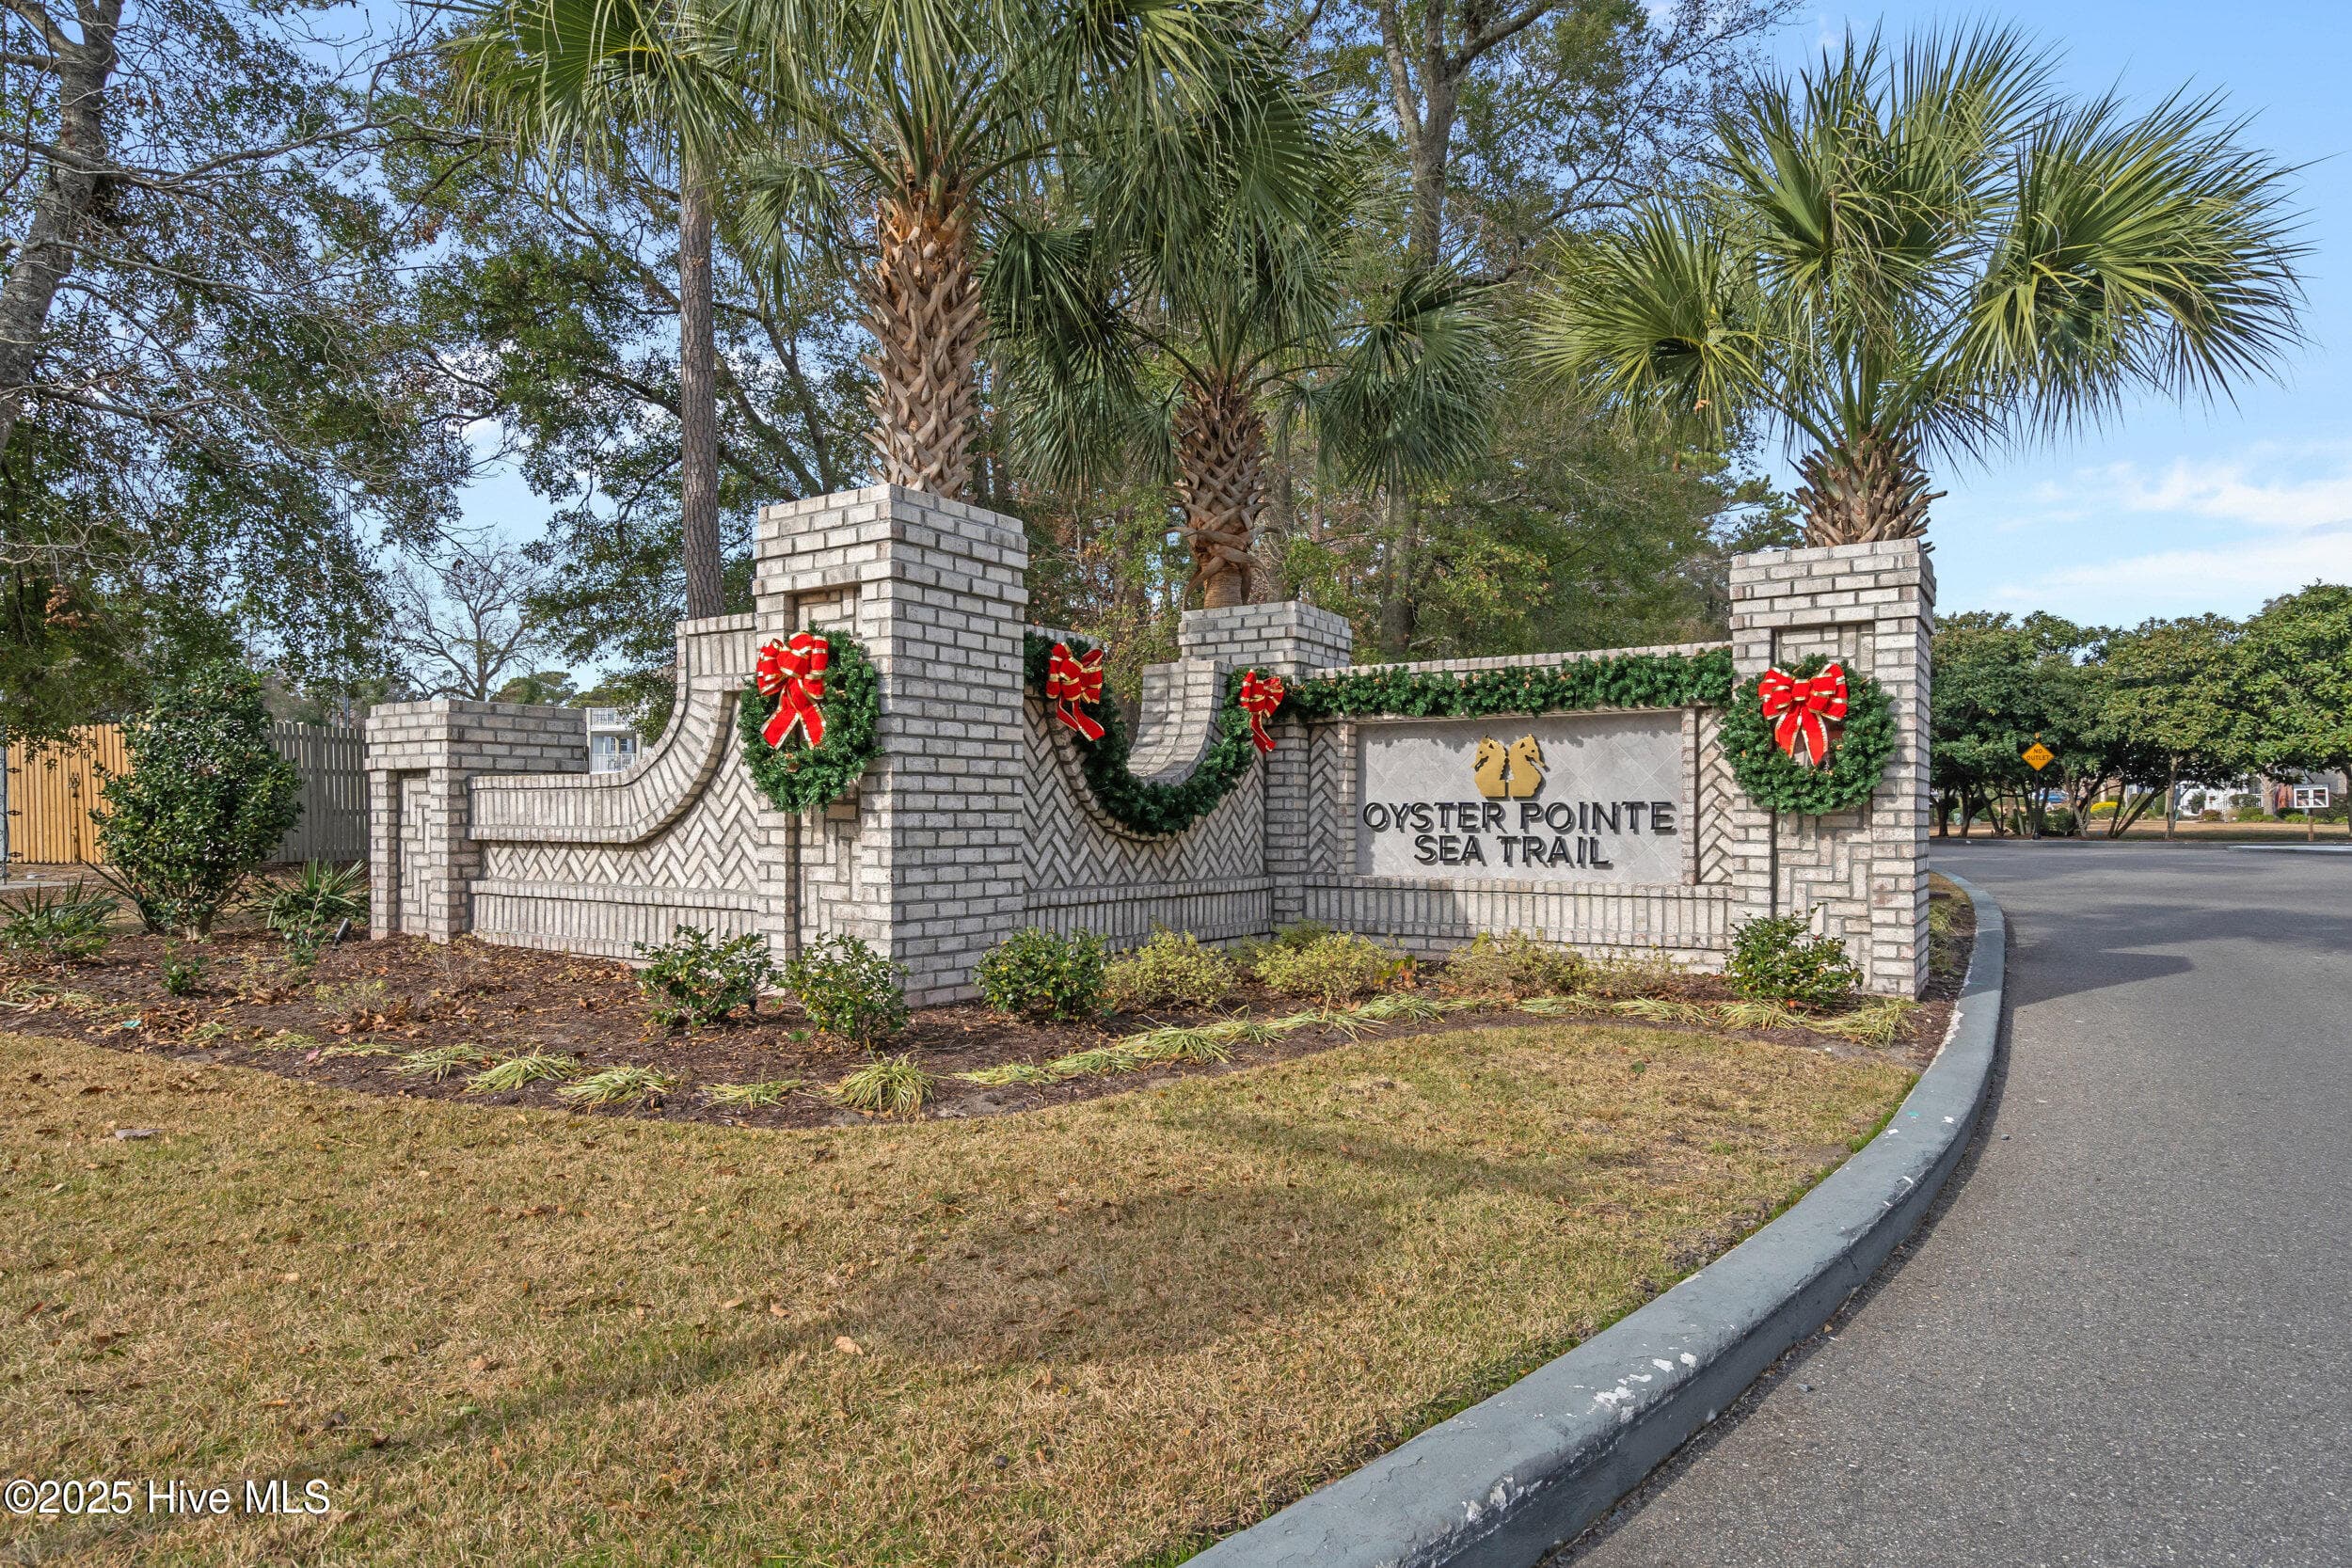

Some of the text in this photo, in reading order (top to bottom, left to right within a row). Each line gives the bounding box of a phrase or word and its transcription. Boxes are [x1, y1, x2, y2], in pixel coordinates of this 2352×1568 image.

[1363, 800, 1676, 832] OYSTER POINTE
[1413, 834, 1612, 866] SEA TRAIL
